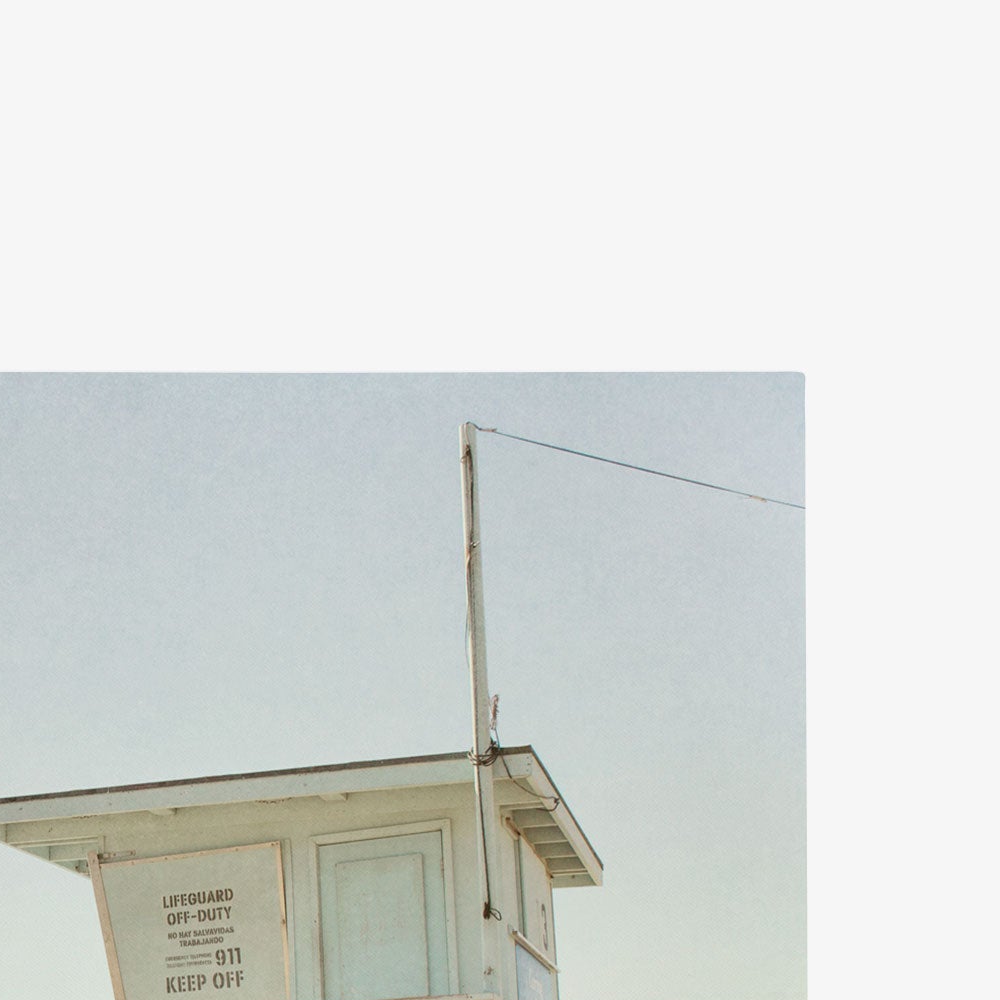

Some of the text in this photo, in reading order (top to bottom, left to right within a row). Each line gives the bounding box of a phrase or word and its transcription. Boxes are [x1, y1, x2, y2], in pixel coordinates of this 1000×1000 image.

[162, 888, 234, 909] LIFEGUARD
[167, 906, 232, 926] OFF-DUTY
[167, 926, 235, 940] NO HAY SALVAVIDAS
[179, 936, 224, 947] TRABAJANDO
[215, 947, 242, 966] 911
[166, 970, 244, 994] KEEP OFF
